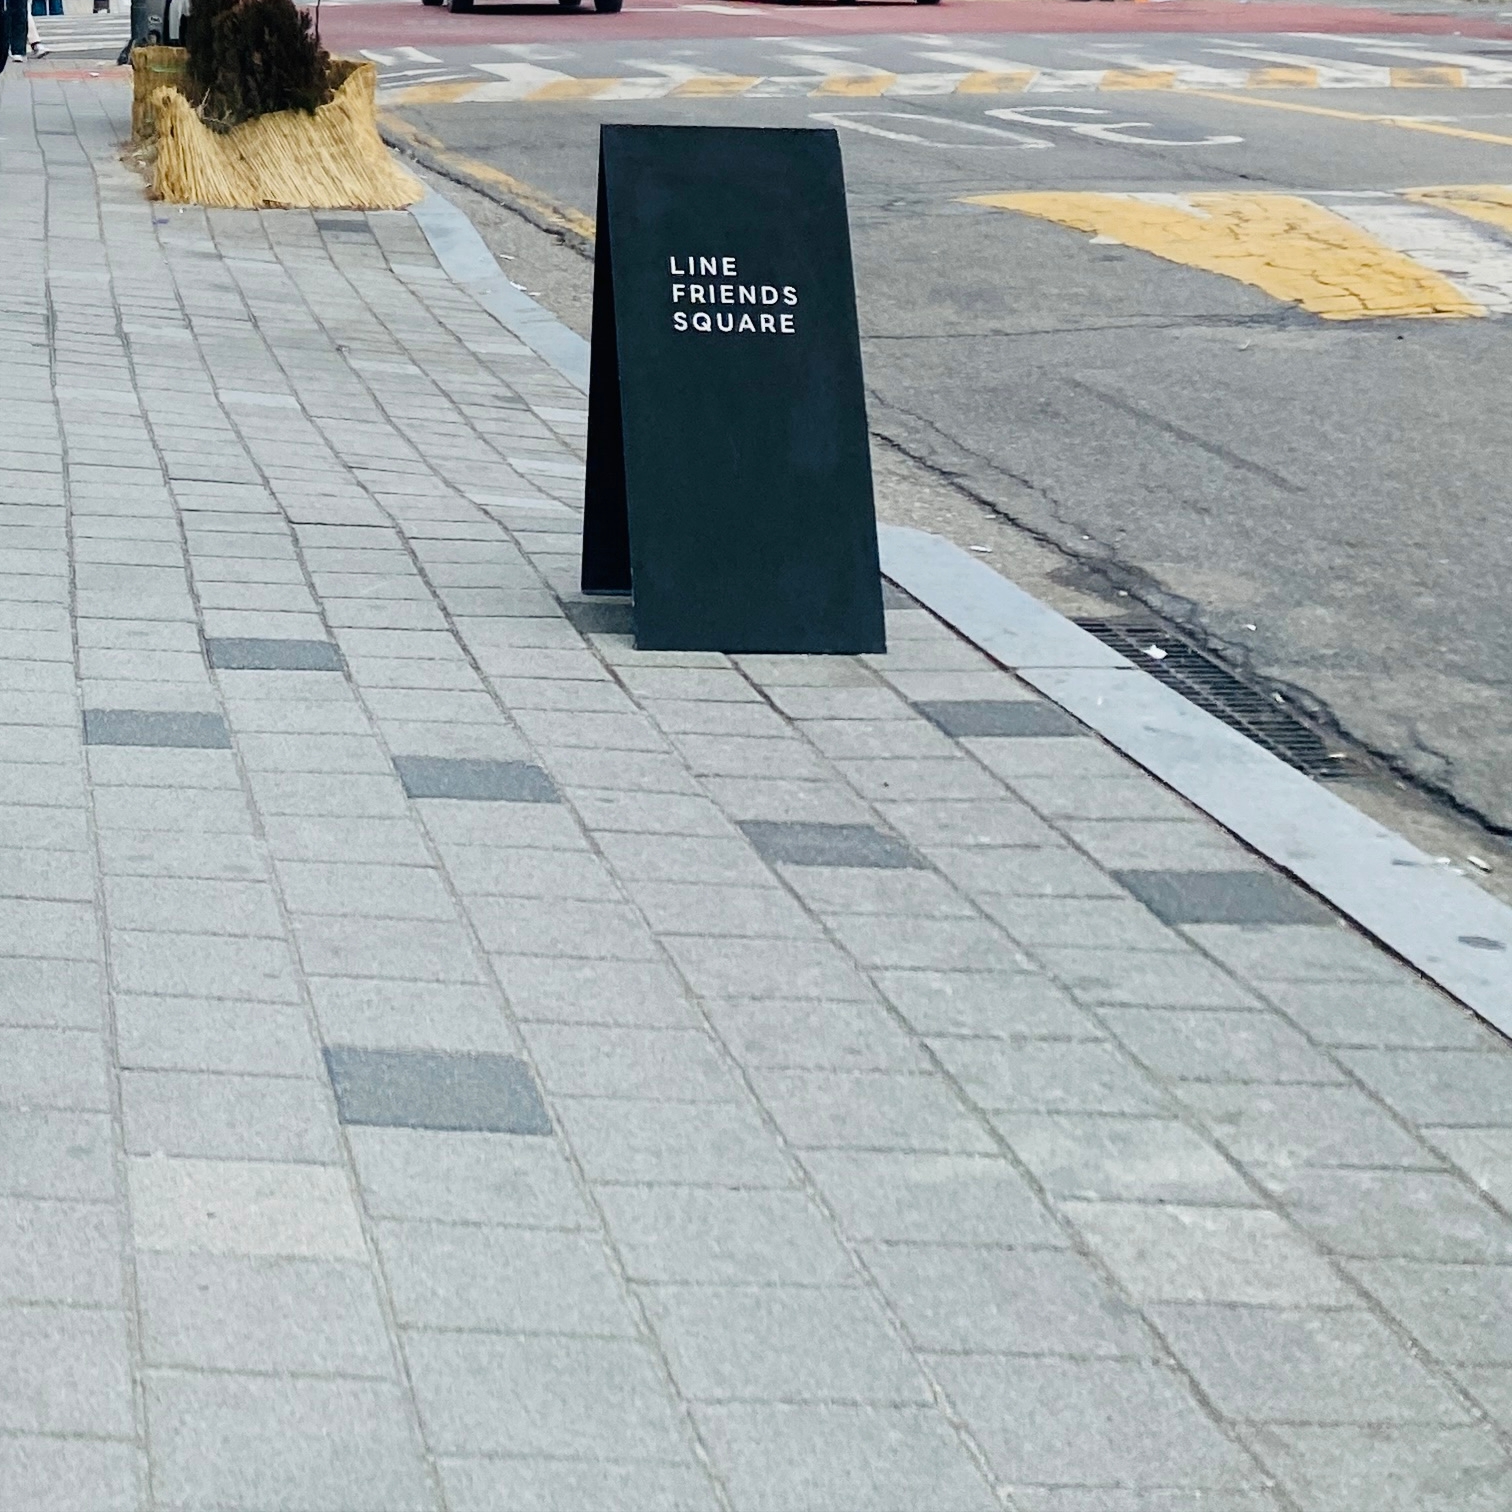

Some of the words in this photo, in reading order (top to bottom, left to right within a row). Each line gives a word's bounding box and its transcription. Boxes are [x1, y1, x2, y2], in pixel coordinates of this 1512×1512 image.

[670, 256, 737, 276] LINE
[672, 283, 798, 306] FRIENDS
[673, 311, 796, 334] SQUARE
